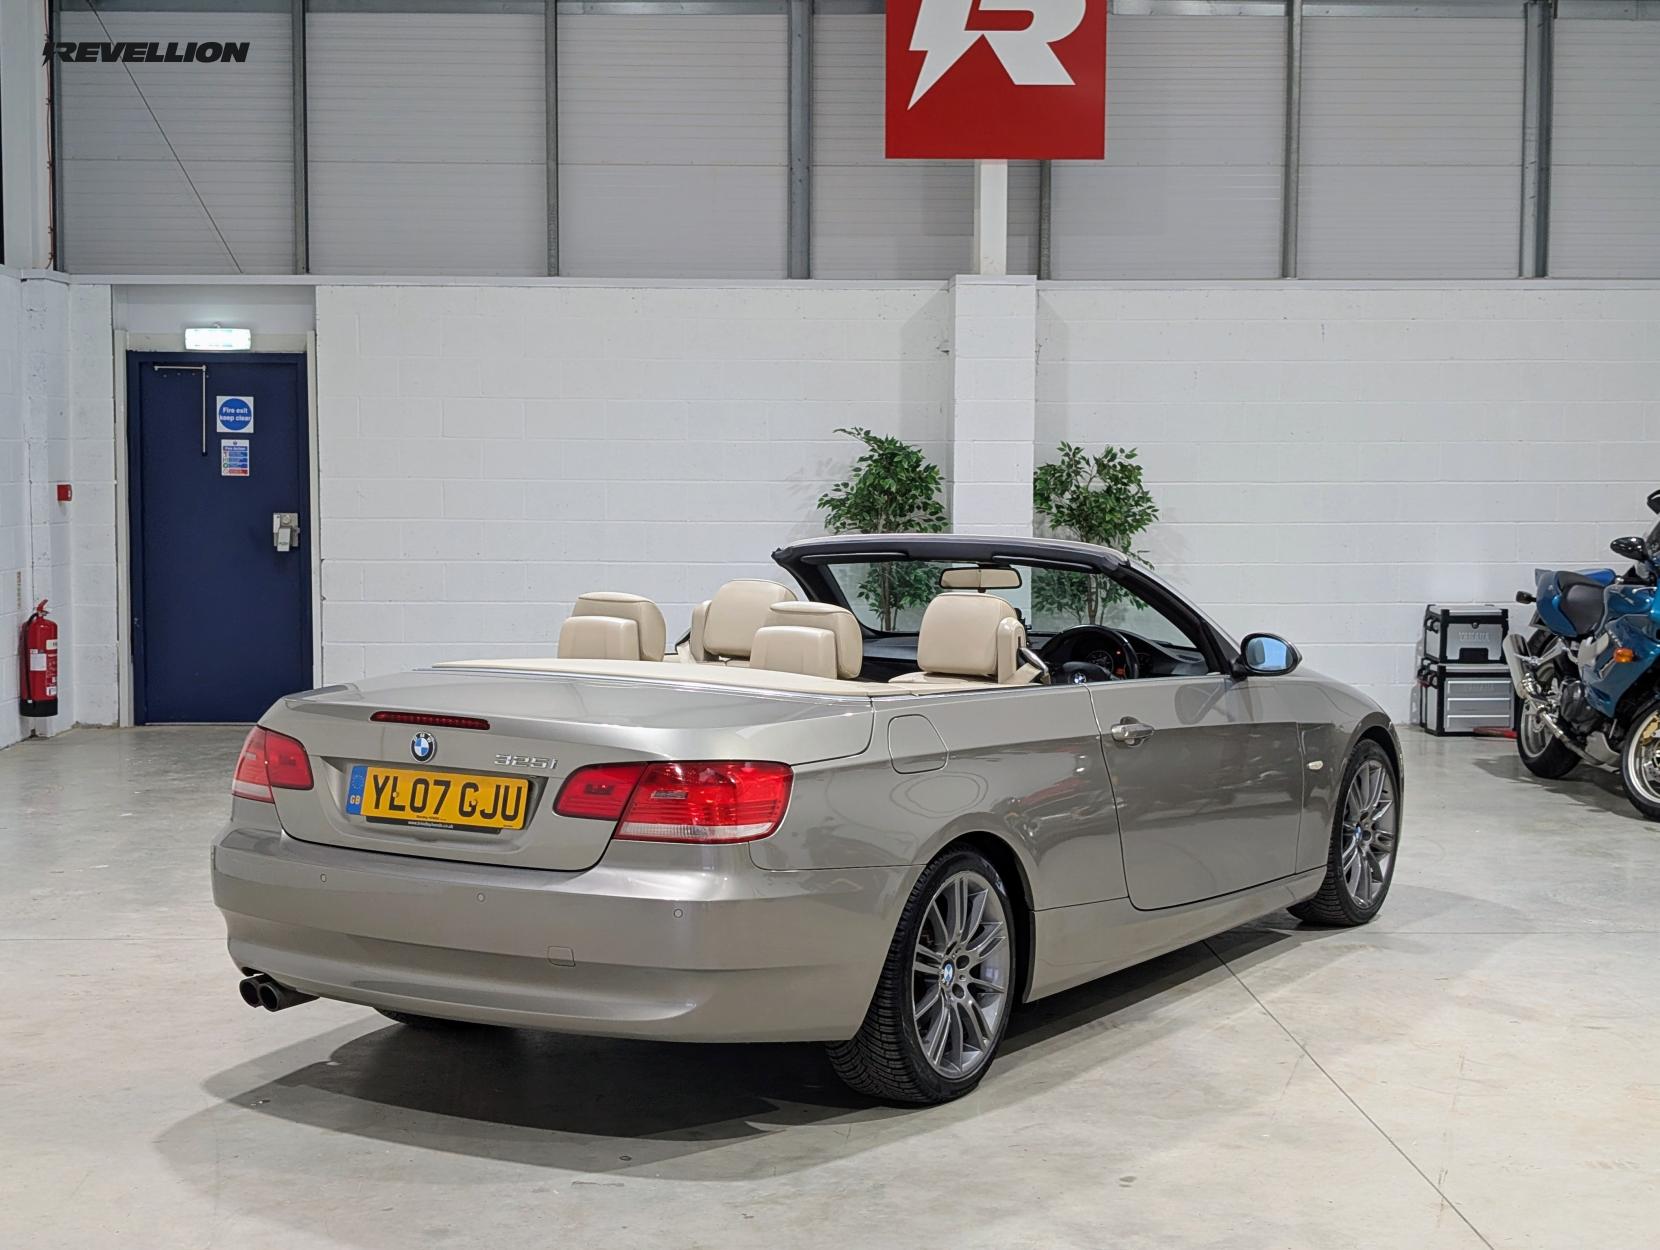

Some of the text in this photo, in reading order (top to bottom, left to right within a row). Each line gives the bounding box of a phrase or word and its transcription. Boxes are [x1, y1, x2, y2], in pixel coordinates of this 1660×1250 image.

[349, 794, 361, 805] GB
[372, 774, 523, 822] YL07 GJU
